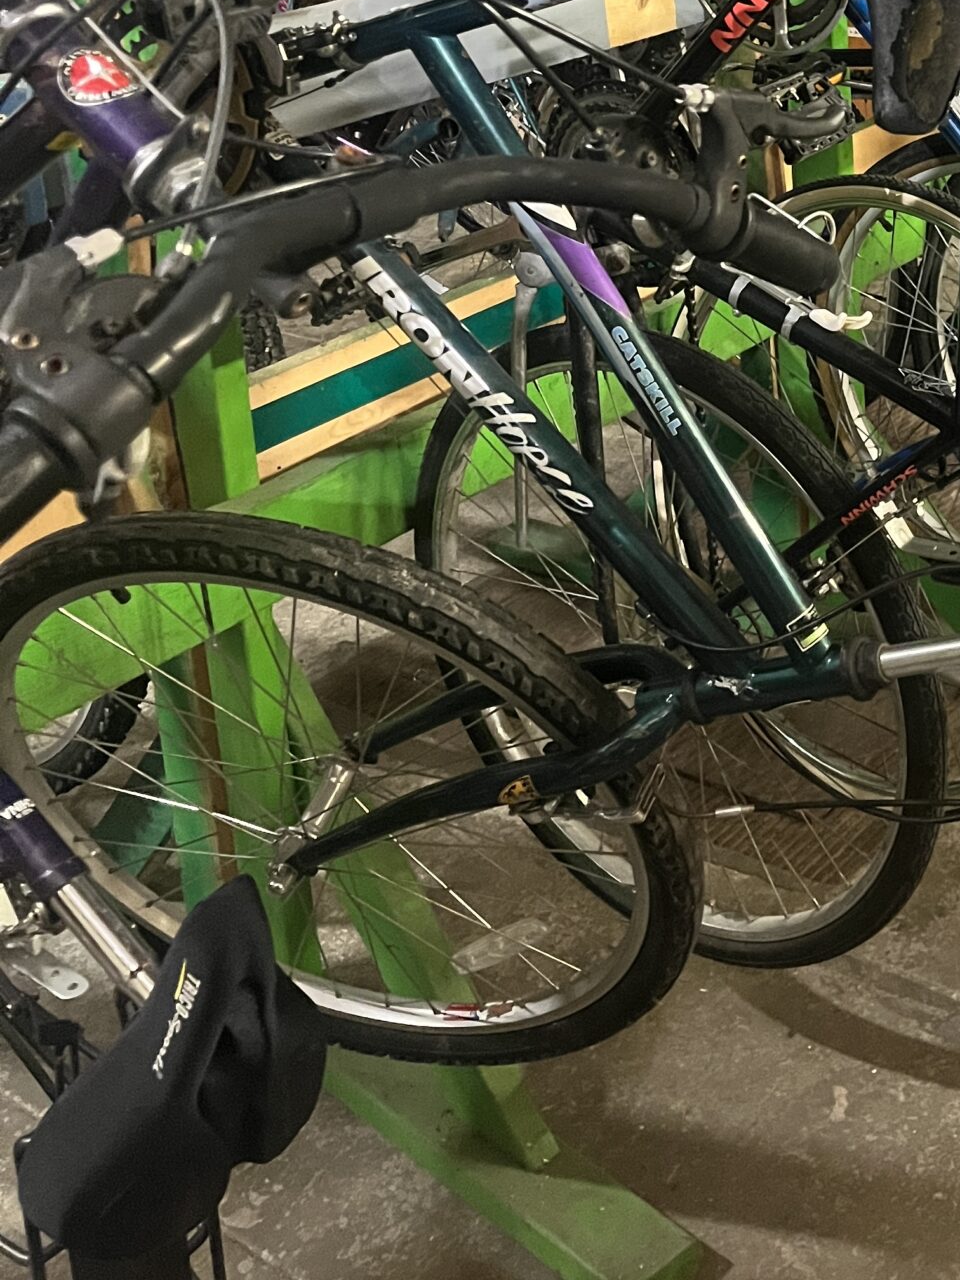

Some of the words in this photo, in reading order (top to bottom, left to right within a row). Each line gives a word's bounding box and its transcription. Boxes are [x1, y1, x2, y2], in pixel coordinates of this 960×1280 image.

[611, 325, 682, 436] CATSKILL
[840, 464, 918, 526] SCHWINN
[176, 973, 201, 1019] TRICO
